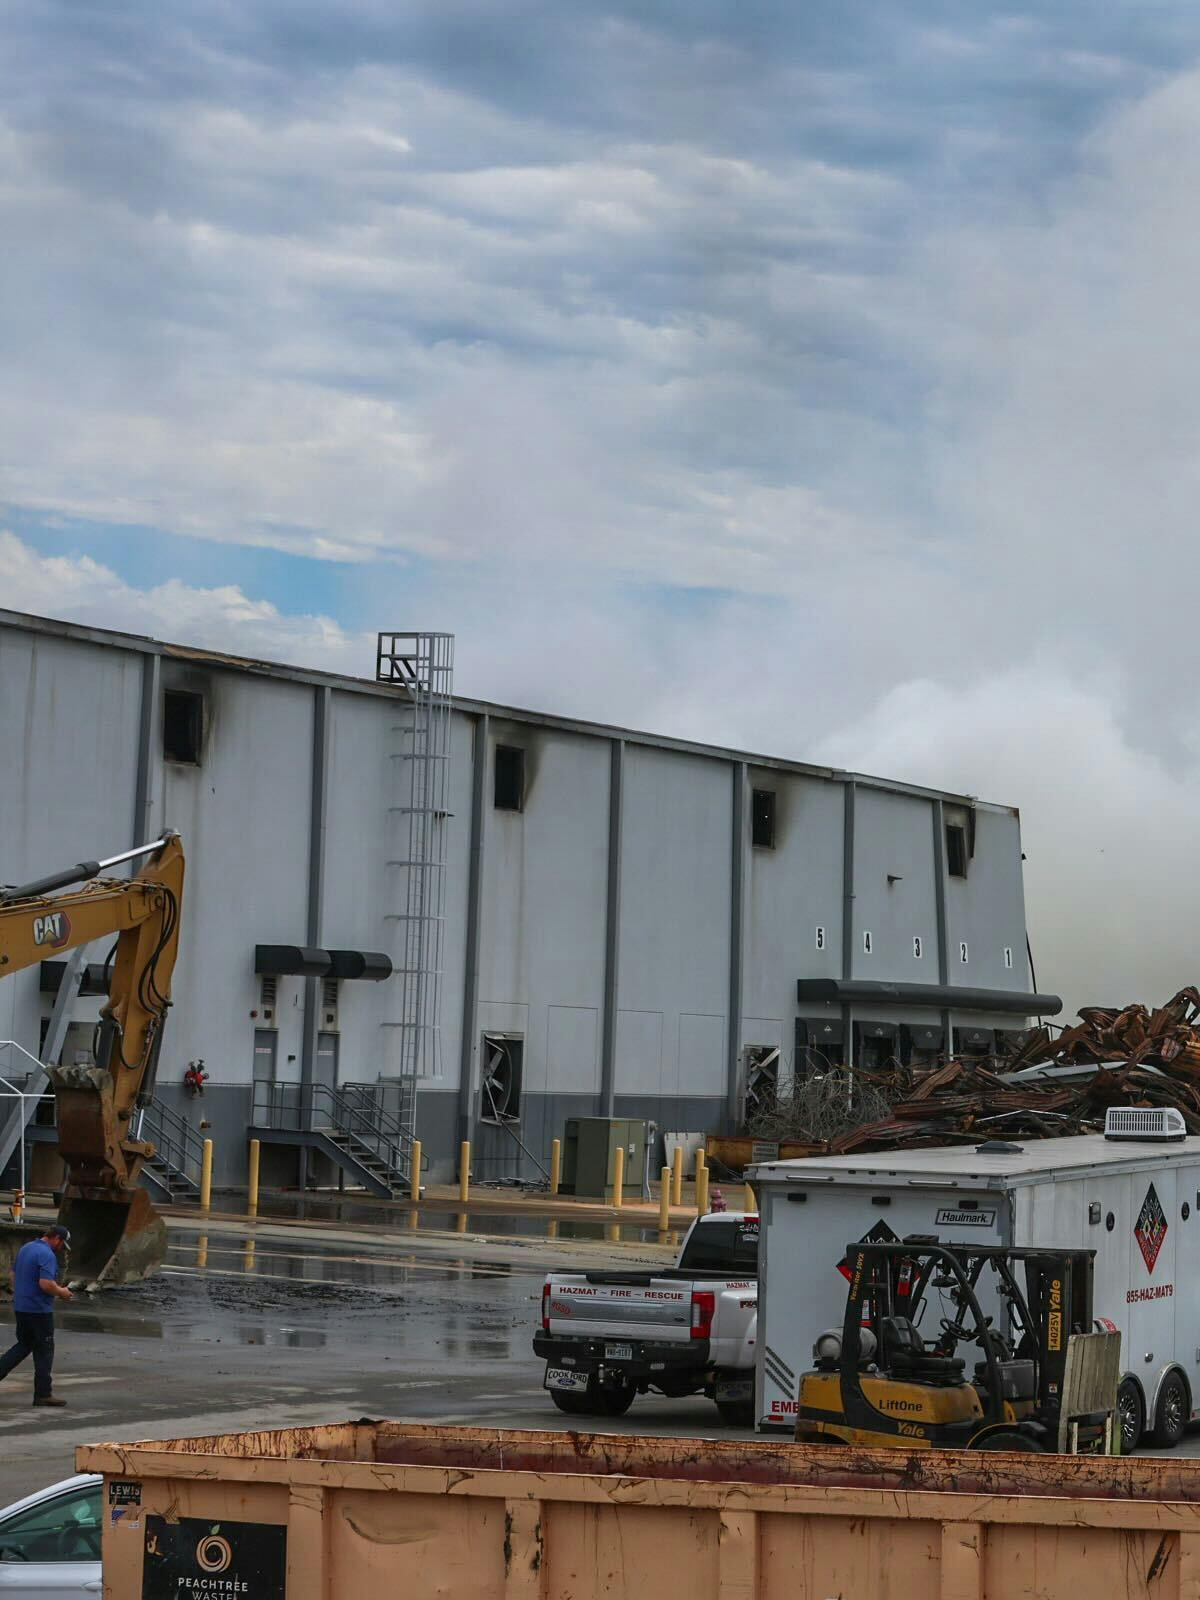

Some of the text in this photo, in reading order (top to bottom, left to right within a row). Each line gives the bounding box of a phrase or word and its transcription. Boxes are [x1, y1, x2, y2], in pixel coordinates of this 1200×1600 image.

[33, 912, 62, 945] CAT
[816, 928, 1011, 967] 5 4 3 2 1
[559, 1286, 684, 1300] HAZMAT FIRE RESCUE
[1049, 1280, 1061, 1310] Yale
[1126, 1284, 1173, 1304] 855-HAZ-MAT9
[1049, 1312, 1060, 1350] 14025V
[548, 1370, 587, 1383] COOK FORD
[879, 1399, 923, 1412] LiftOne
[897, 1421, 925, 1438] Yale
[178, 1577, 248, 1592] PEACHTREE
[192, 1591, 233, 1600] WASTE
